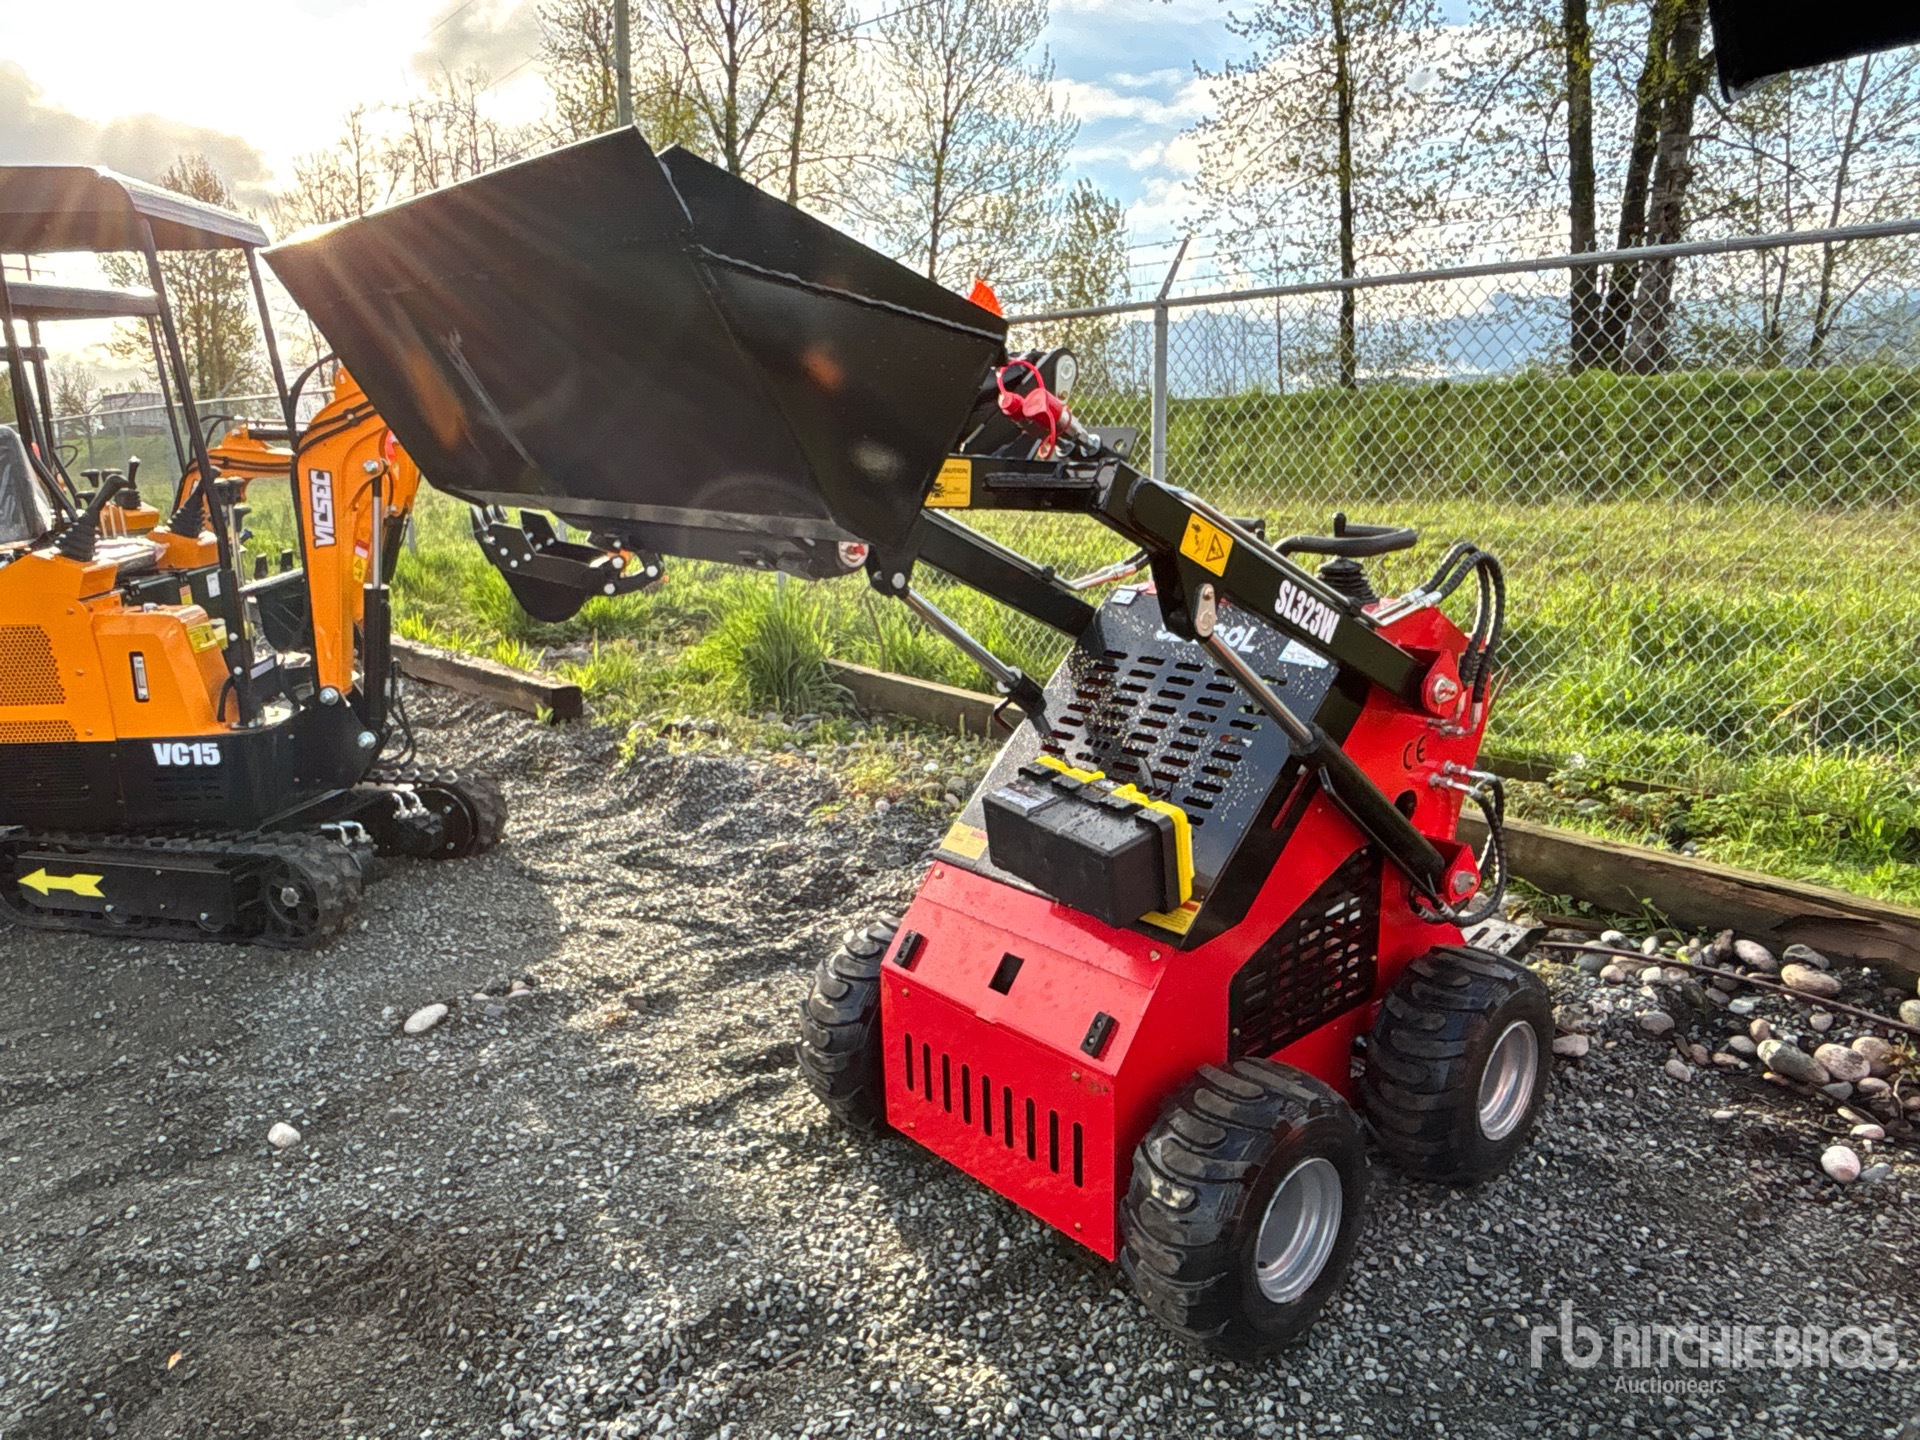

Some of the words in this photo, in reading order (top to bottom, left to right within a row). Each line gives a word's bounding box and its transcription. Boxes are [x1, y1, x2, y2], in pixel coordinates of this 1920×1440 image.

[1274, 580, 1340, 645] SL323W
[152, 742, 221, 766] VC15
[1403, 735, 1426, 770] CE
